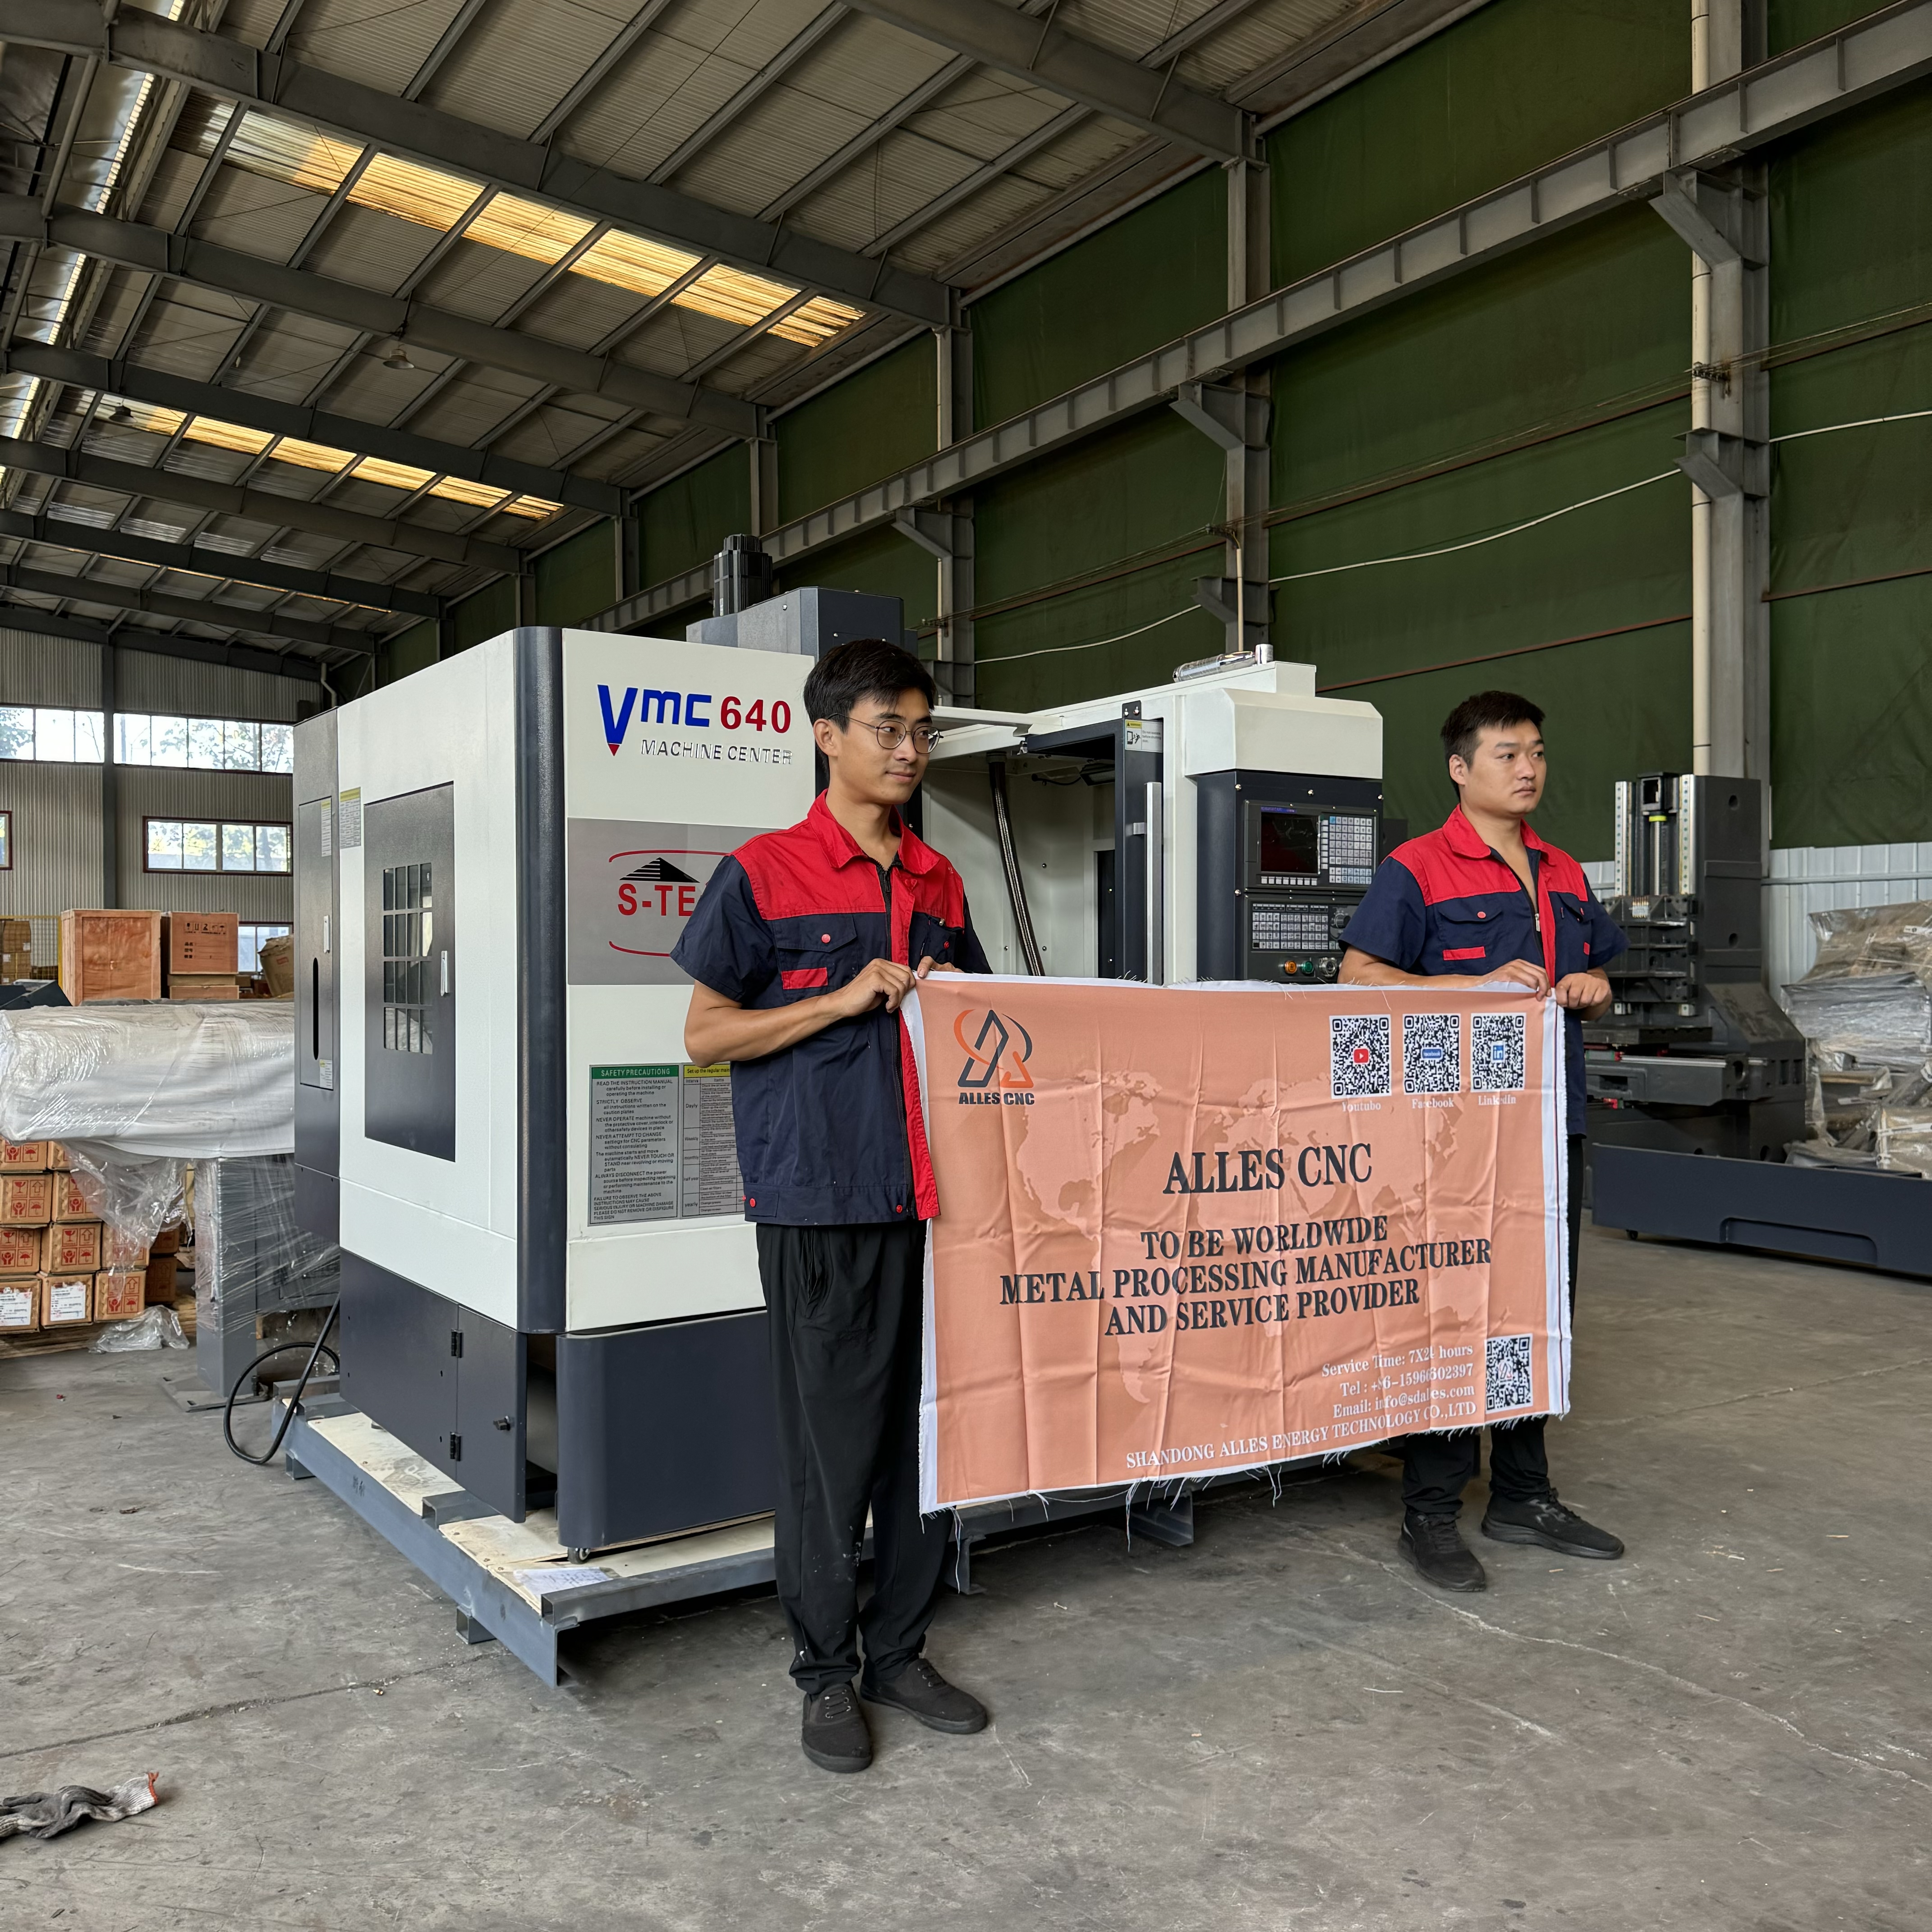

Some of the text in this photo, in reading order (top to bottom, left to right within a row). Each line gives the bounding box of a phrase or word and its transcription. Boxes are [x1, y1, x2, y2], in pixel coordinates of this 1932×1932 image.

[720, 696, 791, 733] 640
[641, 740, 793, 764] MACHINE CENTER
[618, 883, 709, 916] S-TE
[959, 1092, 1035, 1105] ALLES CNC
[1163, 1143, 1372, 1194] ALLES CNC
[1141, 1215, 1388, 1260] TO BE WORLDWIDE
[999, 1238, 1491, 1305] METAL PROCESSING MANUFACTURER
[1104, 1278, 1420, 1336] AND SERVICE PROVIDER
[1321, 1359, 1369, 1377] Service
[1372, 1354, 1405, 1369] Time:
[1439, 1345, 1473, 1359] hours
[1333, 1399, 1371, 1418] Email:
[1126, 1443, 1215, 1468] SHANDONG
[1219, 1436, 1268, 1457] ALLES
[1272, 1426, 1329, 1449] ENERGY
[1332, 1409, 1421, 1438] TECHNOLOGY
